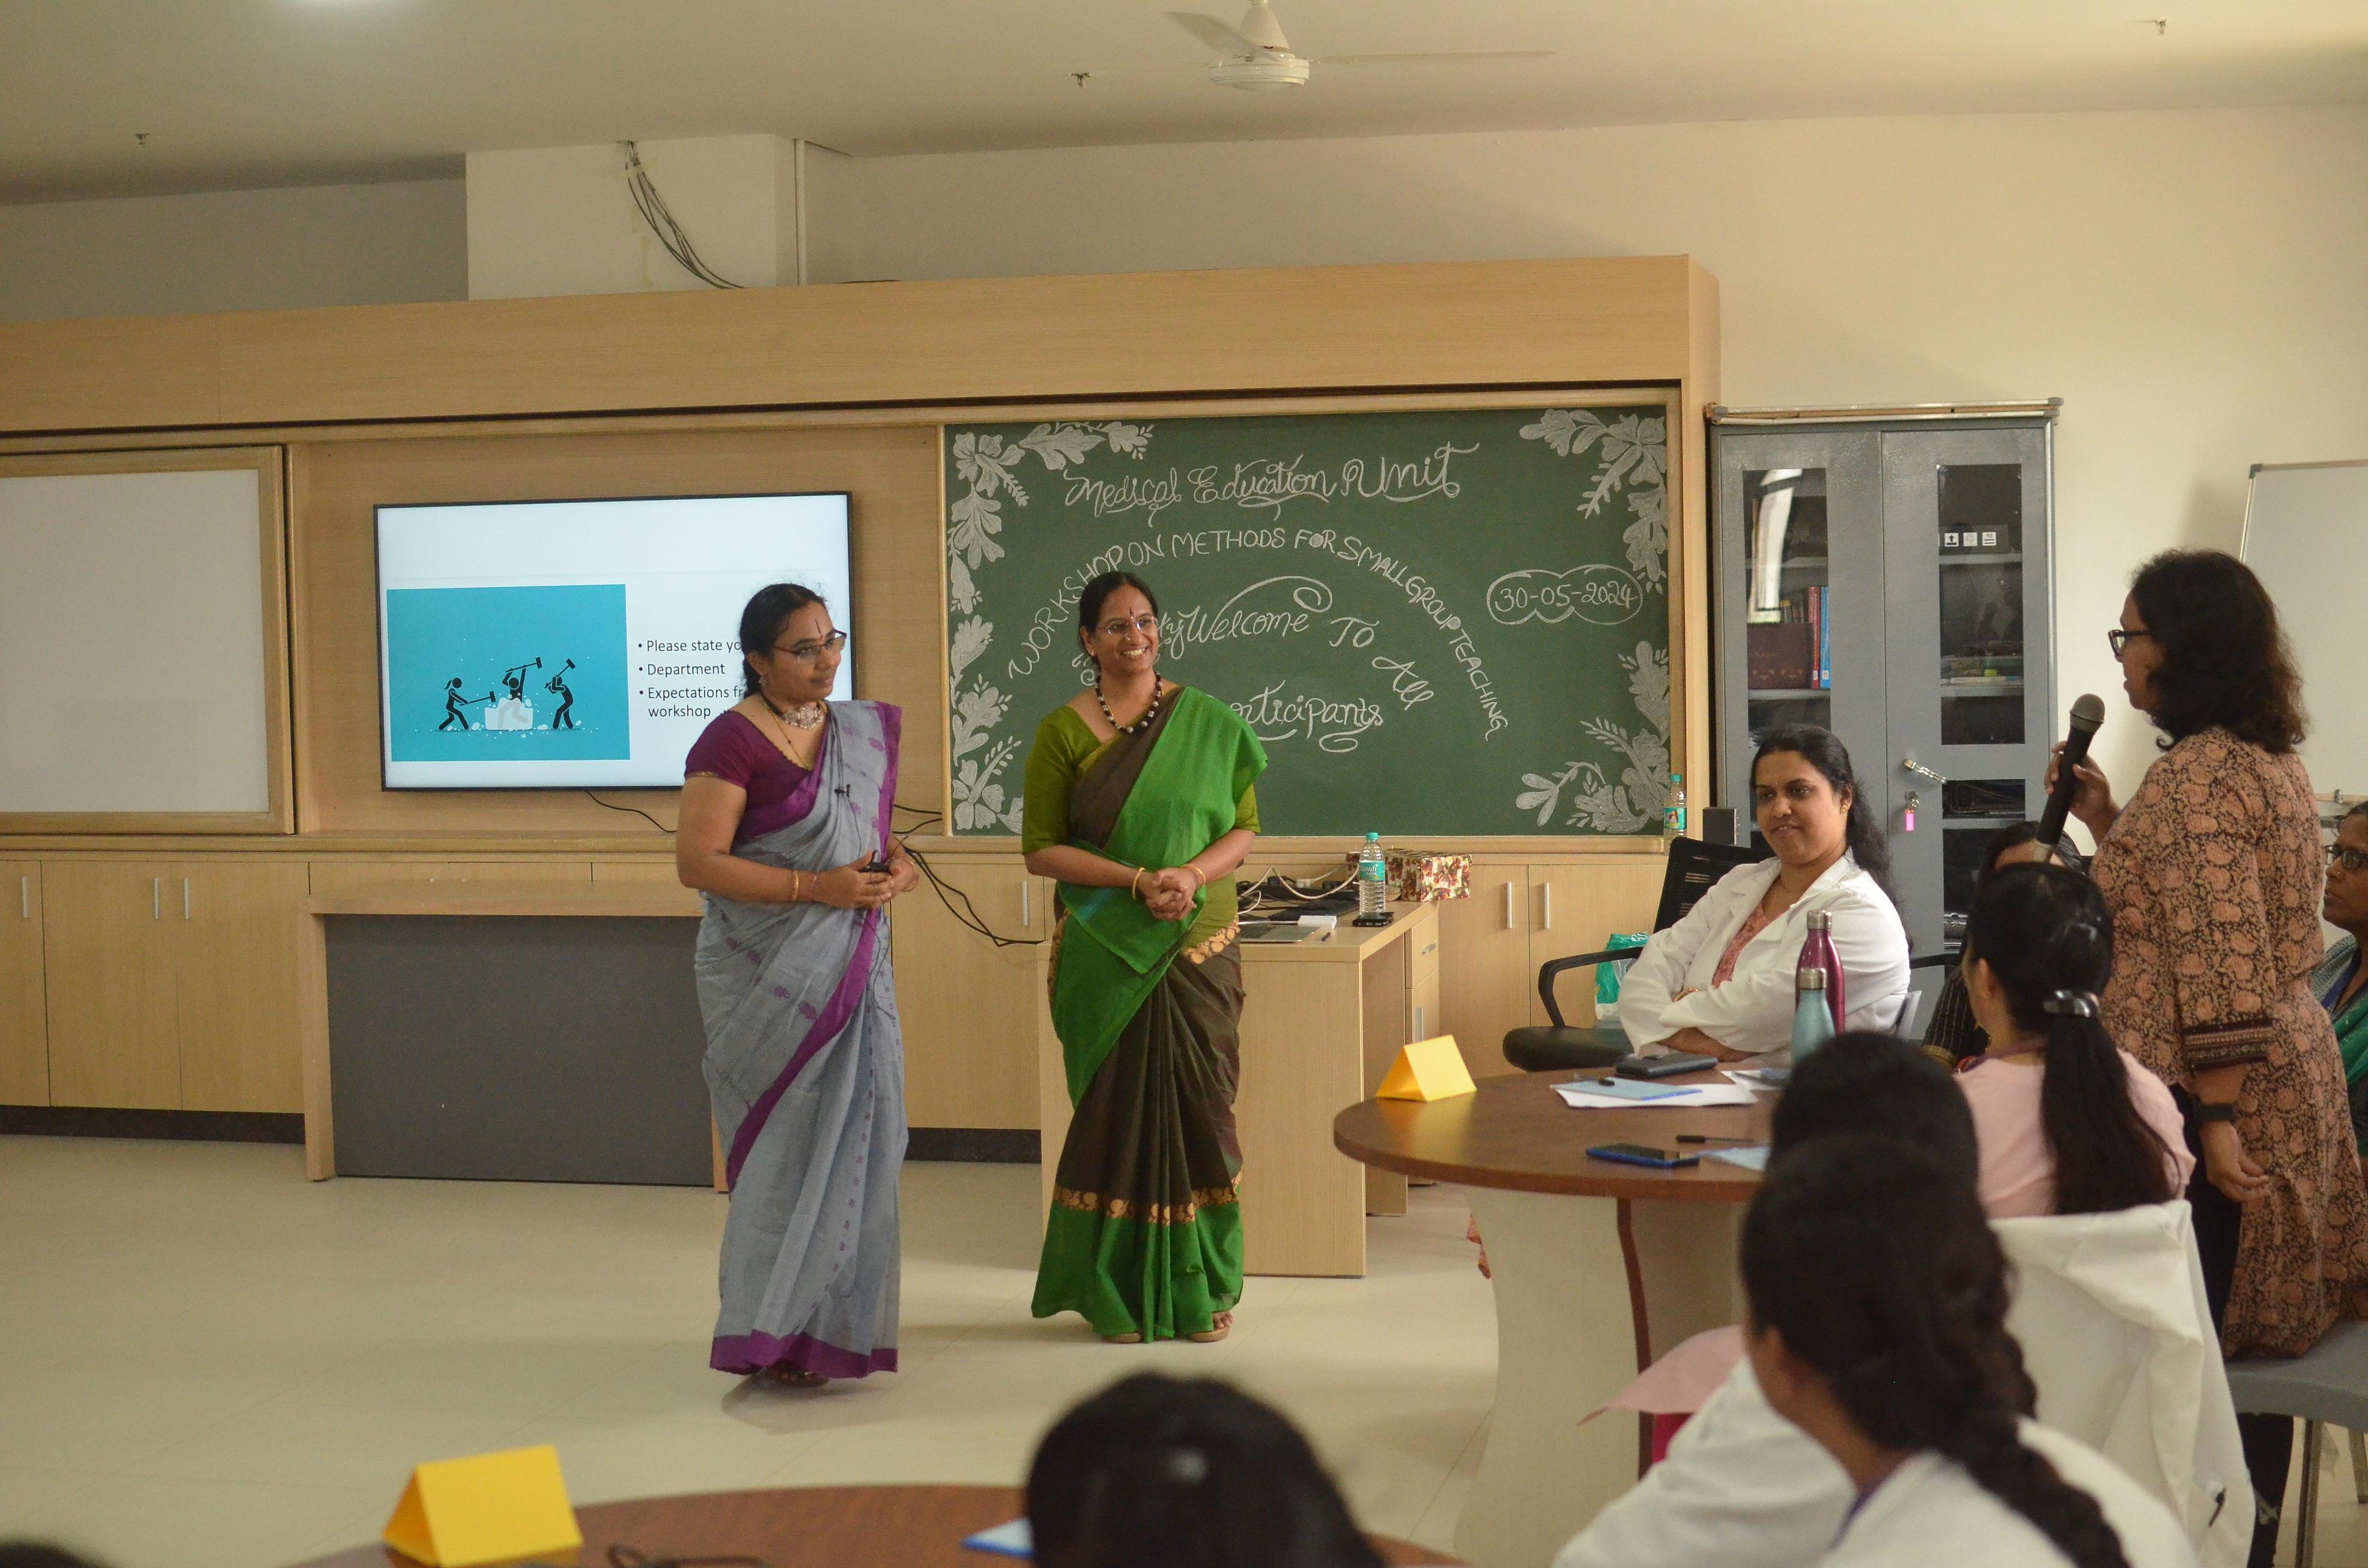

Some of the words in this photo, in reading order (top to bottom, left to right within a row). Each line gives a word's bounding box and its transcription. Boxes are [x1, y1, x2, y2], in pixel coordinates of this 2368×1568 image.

[1063, 467, 1182, 528] Medical
[1188, 454, 1337, 521] Education
[1341, 441, 1480, 502] Unit
[1495, 580, 1638, 611] 30-05-2024
[647, 640, 687, 652] Please
[691, 640, 723, 651] state
[726, 641, 741, 653] yo
[1009, 545, 1123, 679] WORKSHOP
[1128, 534, 1164, 566] ON
[1172, 527, 1285, 557] METHODS
[1295, 528, 1335, 554] FOR
[1337, 536, 1403, 586] SMALL
[1405, 576, 1461, 629] GROUP
[1449, 629, 1508, 741] TEACHING
[648, 664, 725, 677] Department
[1371, 656, 1434, 710] All
[648, 686, 729, 701] Expectations
[733, 686, 747, 698] fr
[648, 704, 711, 719] workshop
[1219, 680, 1384, 752] articipants
